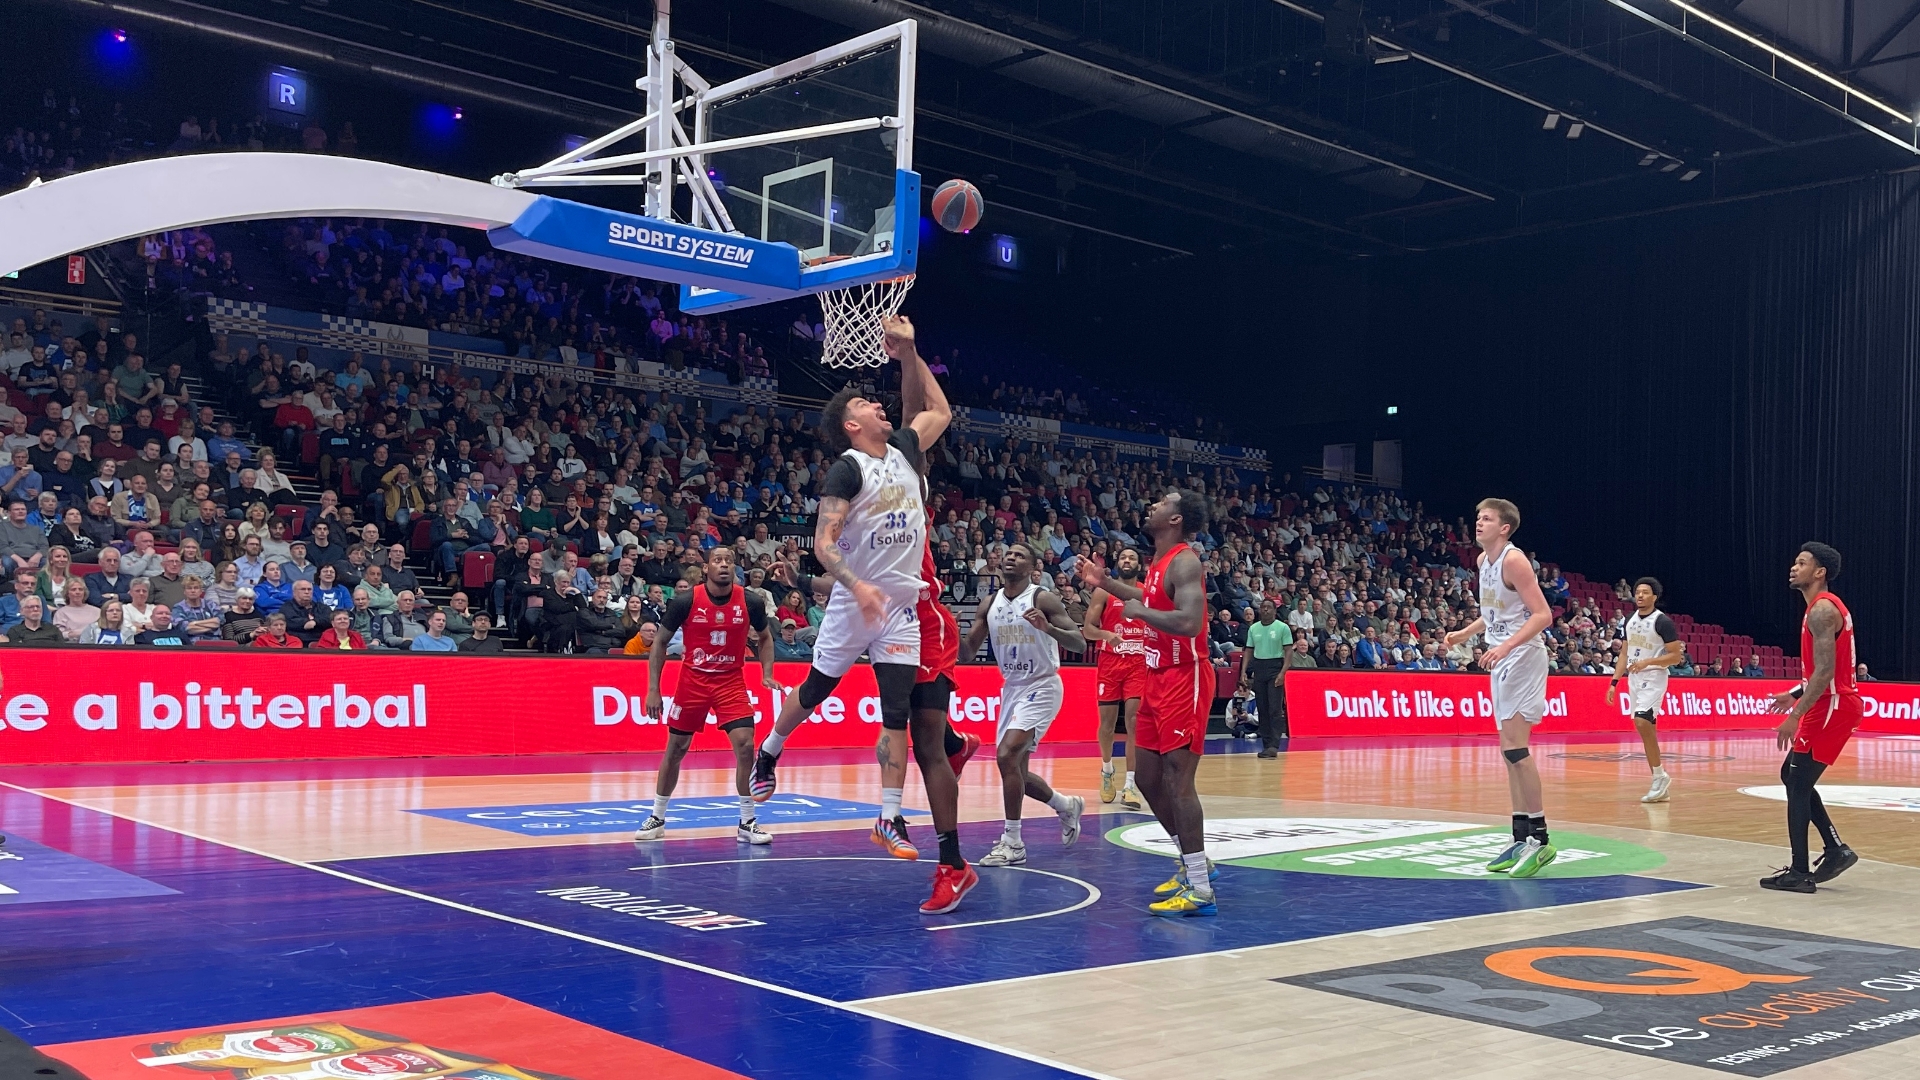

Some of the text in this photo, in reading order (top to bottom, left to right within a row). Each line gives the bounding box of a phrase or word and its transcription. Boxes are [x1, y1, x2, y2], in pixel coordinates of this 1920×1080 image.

[279, 83, 297, 105] R
[609, 222, 755, 263] SPORT SYSTEM
[1001, 245, 1012, 263] U
[422, 364, 435, 380] H
[1186, 463, 1192, 475] L
[885, 511, 907, 529] 33
[904, 607, 917, 622] 3
[710, 630, 727, 646] 11
[1010, 646, 1018, 659] 4
[0, 682, 427, 732] e a bitterbal
[860, 696, 884, 724] a
[1325, 690, 1389, 718] Dunk
[1391, 691, 1411, 718] it
[1414, 690, 1454, 718] like
[1460, 698, 1474, 717] a
[1667, 692, 1681, 716] it
[1683, 692, 1711, 716] like
[1715, 698, 1727, 716] a
[536, 886, 767, 931] EXCEPTION
[1317, 927, 1900, 1027] BQA
[1582, 1026, 1710, 1051] be
[1698, 987, 1890, 1030] quality
[1706, 1044, 1791, 1066] TESTING
[1796, 1030, 1845, 1046] DATA
